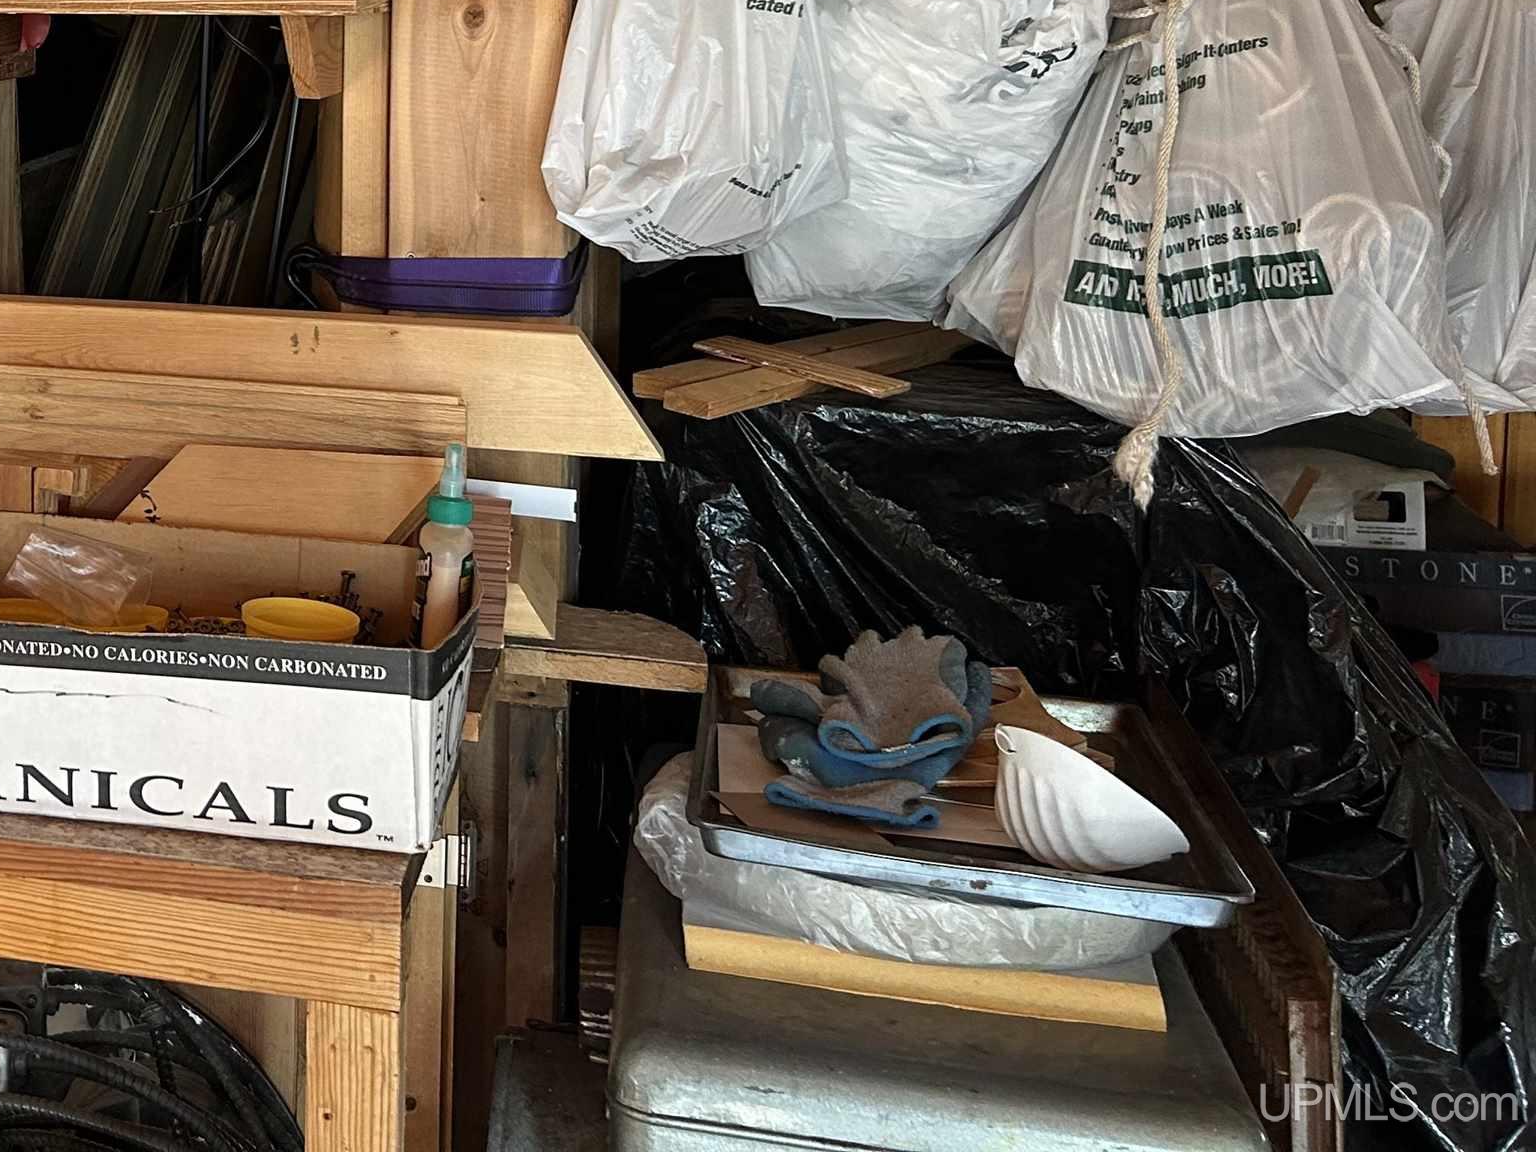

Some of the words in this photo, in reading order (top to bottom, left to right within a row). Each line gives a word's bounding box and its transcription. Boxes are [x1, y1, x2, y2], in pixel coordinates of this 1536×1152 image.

[1187, 233, 1229, 252] Prices
[1173, 267, 1248, 308] MUCH,
[71, 643, 99, 660] NO
[254, 657, 387, 681] CARBONATED
